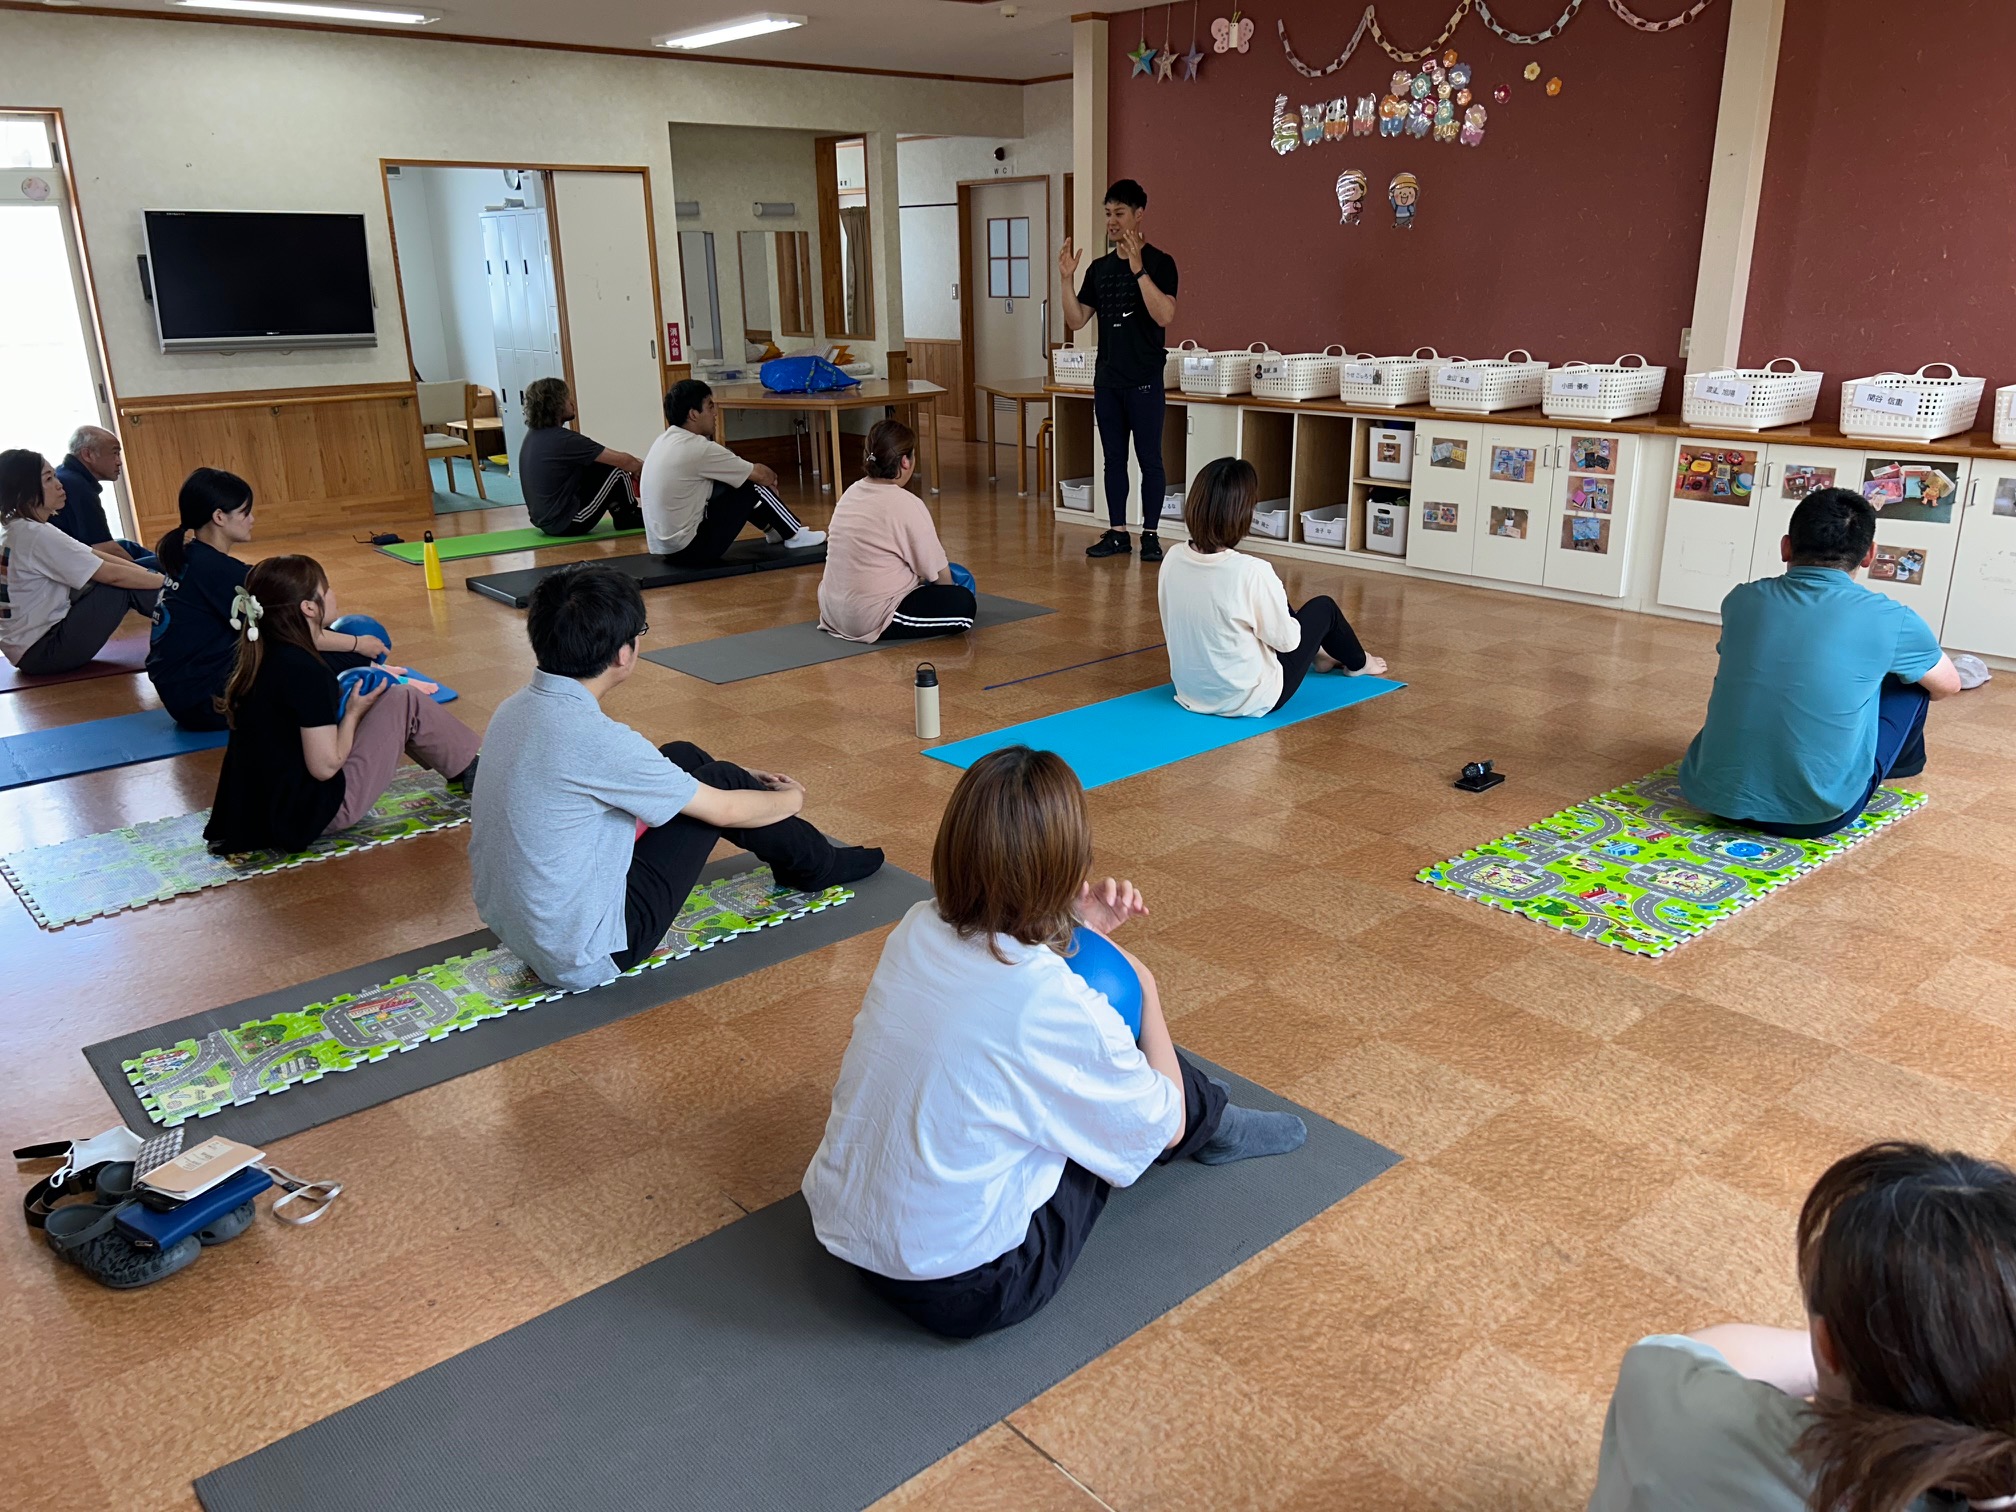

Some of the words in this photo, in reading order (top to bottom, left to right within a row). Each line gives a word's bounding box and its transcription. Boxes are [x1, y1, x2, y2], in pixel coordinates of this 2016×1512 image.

[670, 327, 680, 357] 消火器
[1561, 382, 1574, 390] 小田
[1866, 393, 1883, 403] 関谷
